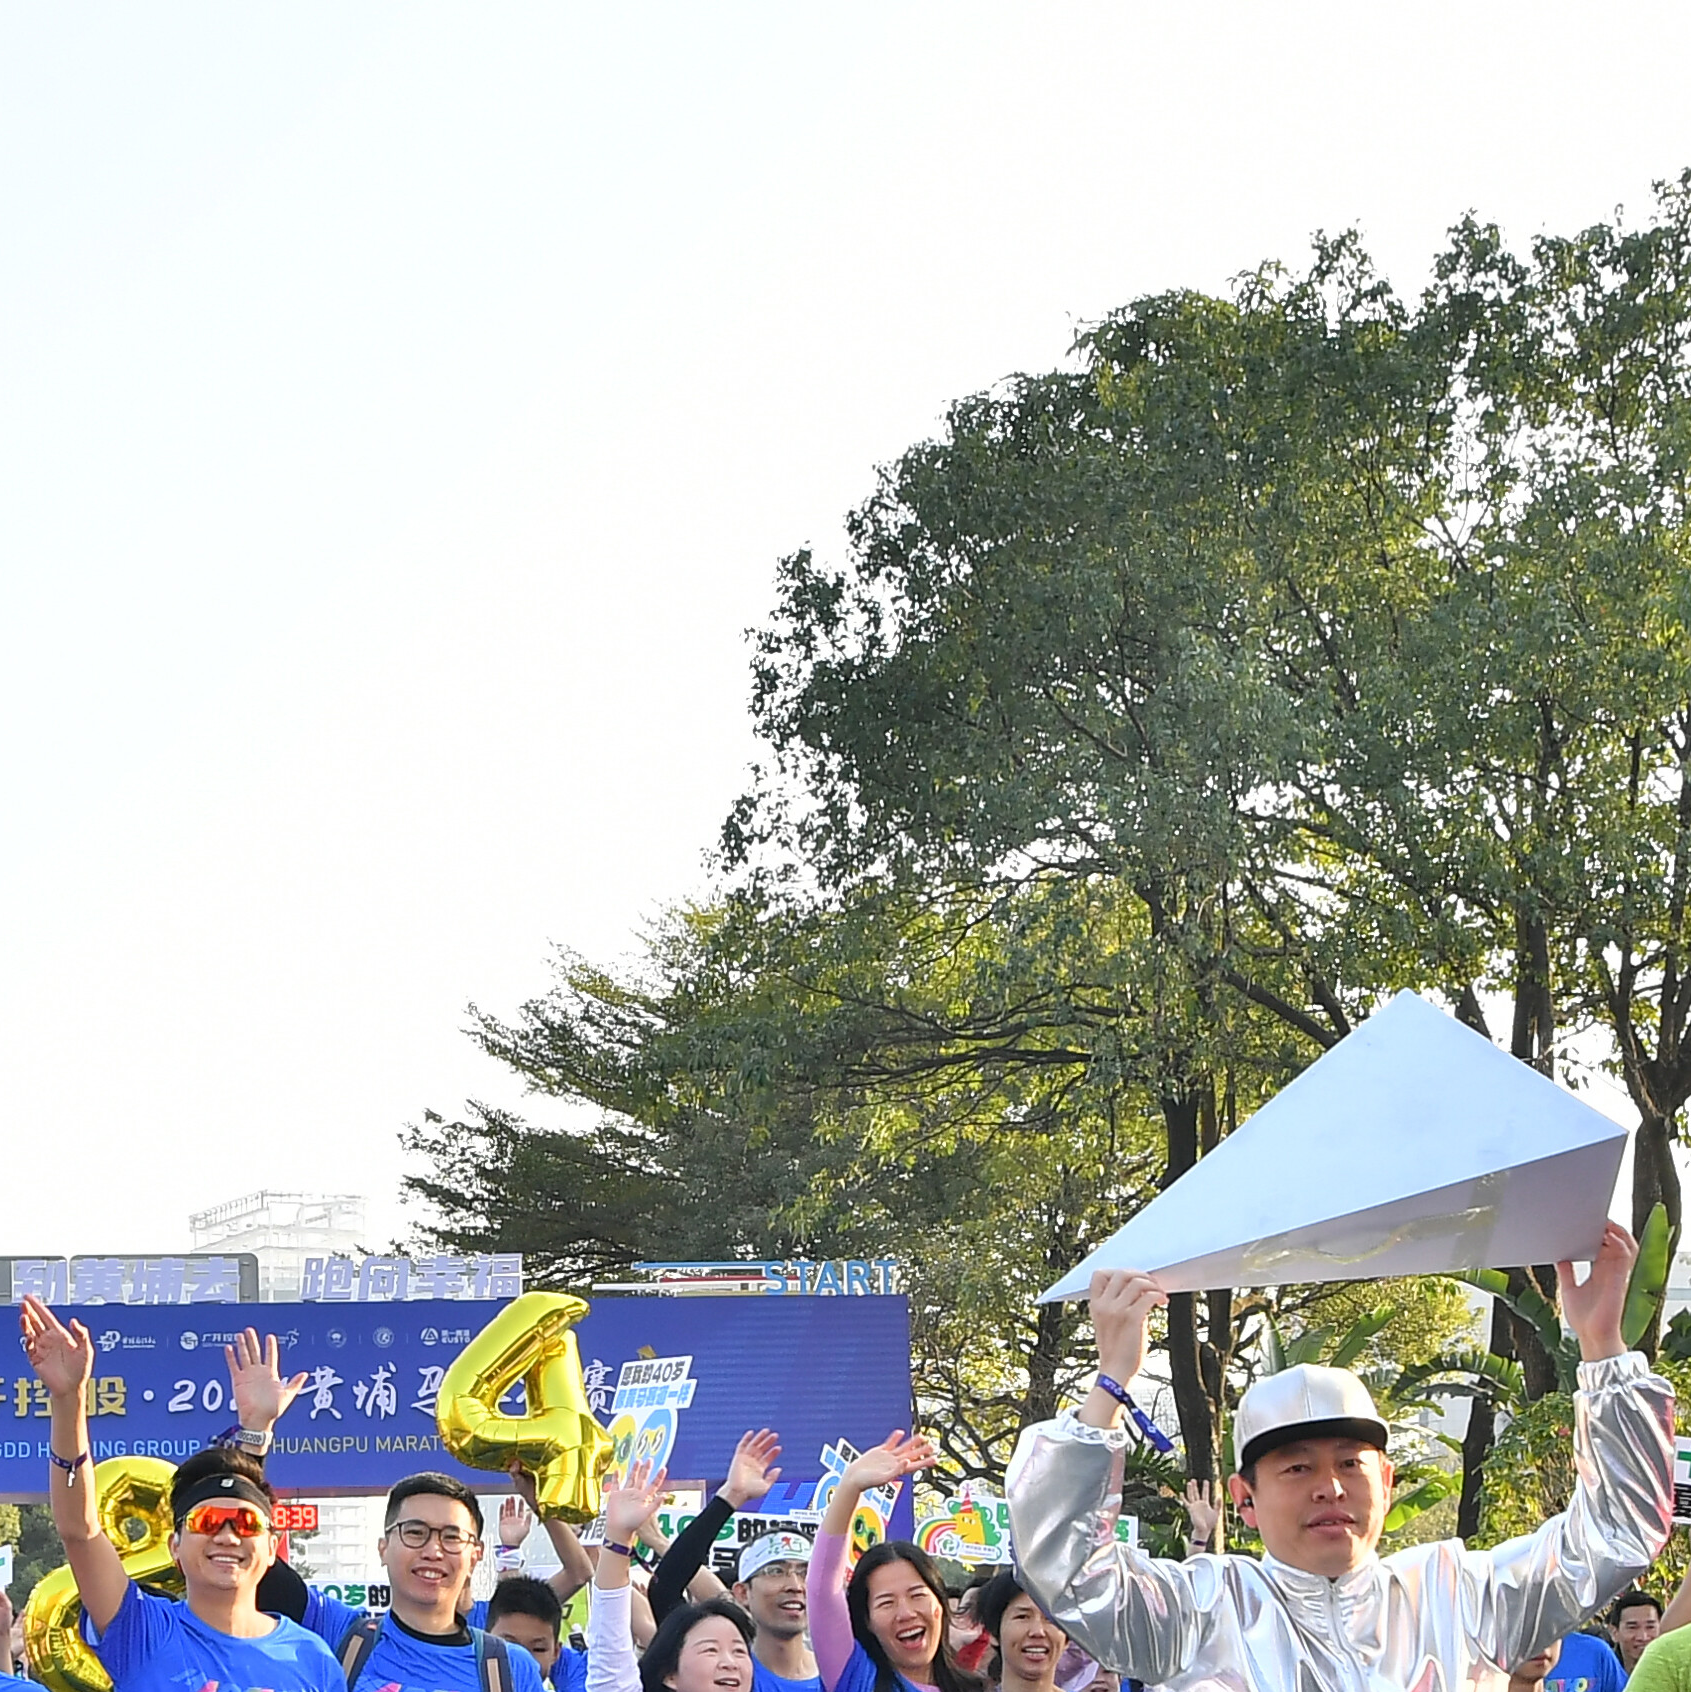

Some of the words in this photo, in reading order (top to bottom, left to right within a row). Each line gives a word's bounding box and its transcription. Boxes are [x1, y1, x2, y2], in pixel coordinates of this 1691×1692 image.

[12, 1256, 240, 1302] 到黄埔去
[300, 1253, 521, 1300] 跑向幸福
[765, 1260, 898, 1296] START
[37, 1439, 126, 1457] HING
[133, 1438, 201, 1456] GROUP
[272, 1434, 369, 1454] HUANGPU
